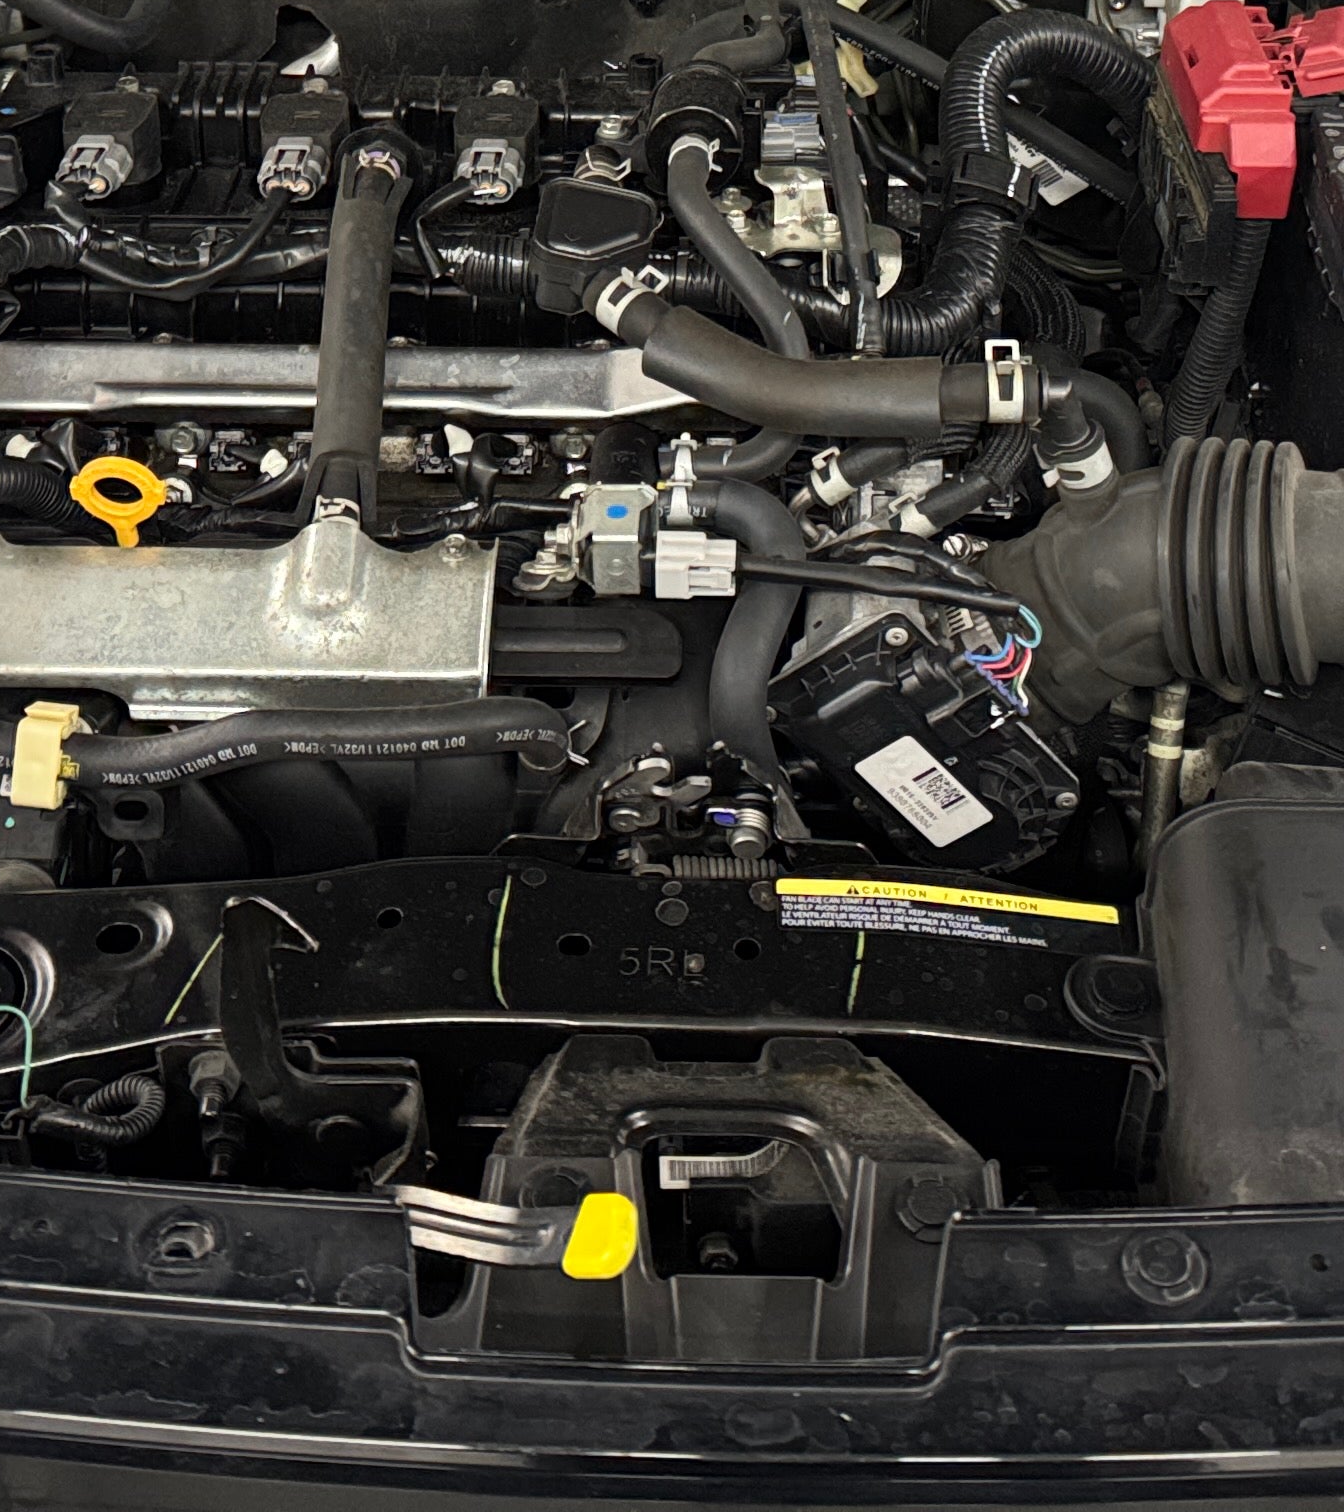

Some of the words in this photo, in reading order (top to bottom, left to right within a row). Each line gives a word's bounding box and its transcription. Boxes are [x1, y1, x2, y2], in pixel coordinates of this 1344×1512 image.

[237, 743, 257, 757] DOT
[375, 741, 416, 753] 040121
[445, 736, 465, 748] DOT
[180, 754, 216, 774] 040121
[798, 895, 822, 904] BLADE
[823, 896, 840, 904] CAN
[841, 897, 864, 905] START
[862, 886, 927, 898] CAUTION
[960, 895, 1038, 911] ATTENTION
[782, 910, 791, 918] LE
[792, 909, 847, 922] VENTILATEUR
[849, 913, 878, 922] RISQUE
[947, 921, 970, 930] TOUT
[794, 903, 813, 911] HELP
[815, 904, 838, 912] AVOID
[839, 905, 879, 915] PERSONAL
[908, 909, 926, 917] KEEP
[927, 912, 955, 921] HANDS
[781, 917, 806, 927] POUR
[836, 920, 863, 929] TOUTE
[908, 924, 920, 932] NE
[921, 925, 937, 934] PAS
[939, 927, 950, 935] EN
[951, 929, 1002, 942] APPROCHER
